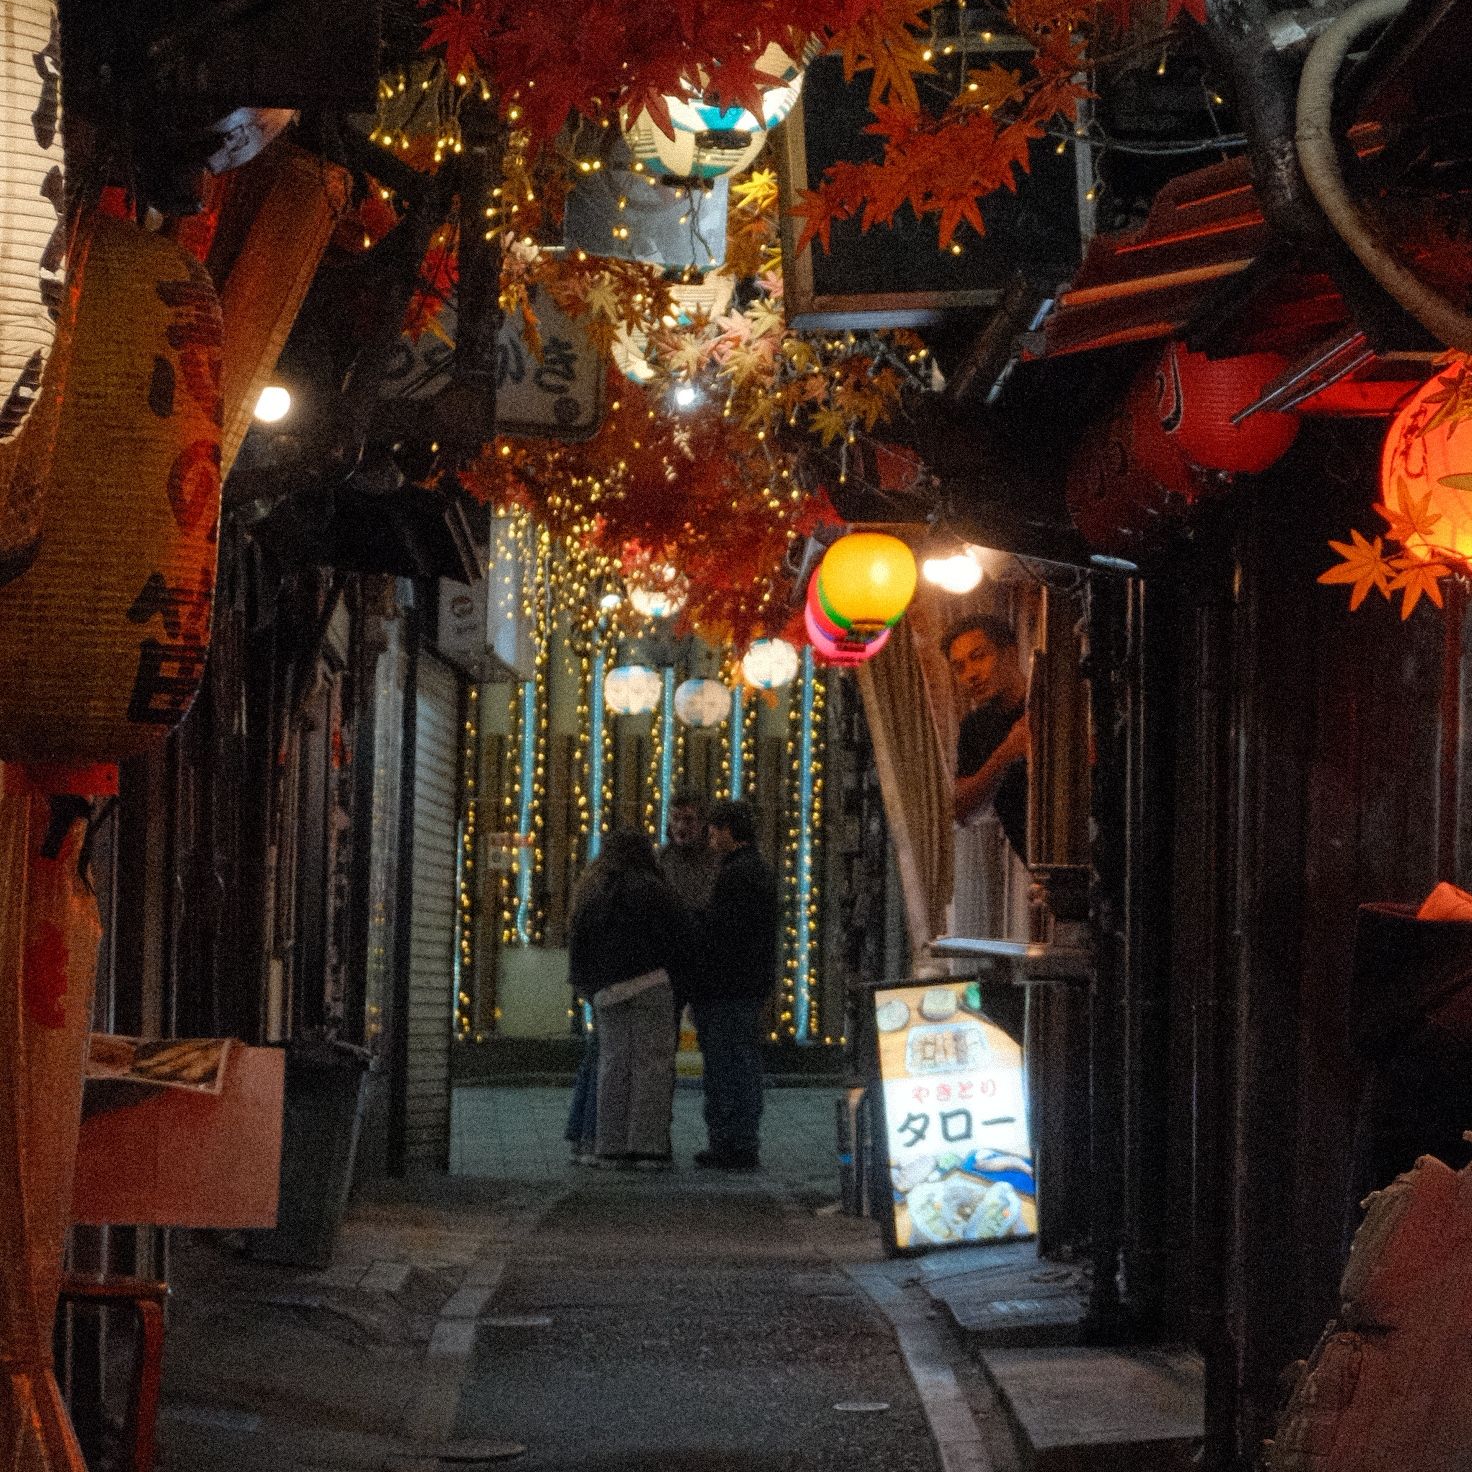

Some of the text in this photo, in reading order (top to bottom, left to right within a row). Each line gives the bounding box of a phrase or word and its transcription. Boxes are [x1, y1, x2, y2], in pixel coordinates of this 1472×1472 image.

[911, 1077, 998, 1105] やきとり
[896, 1107, 1017, 1148] タロー
